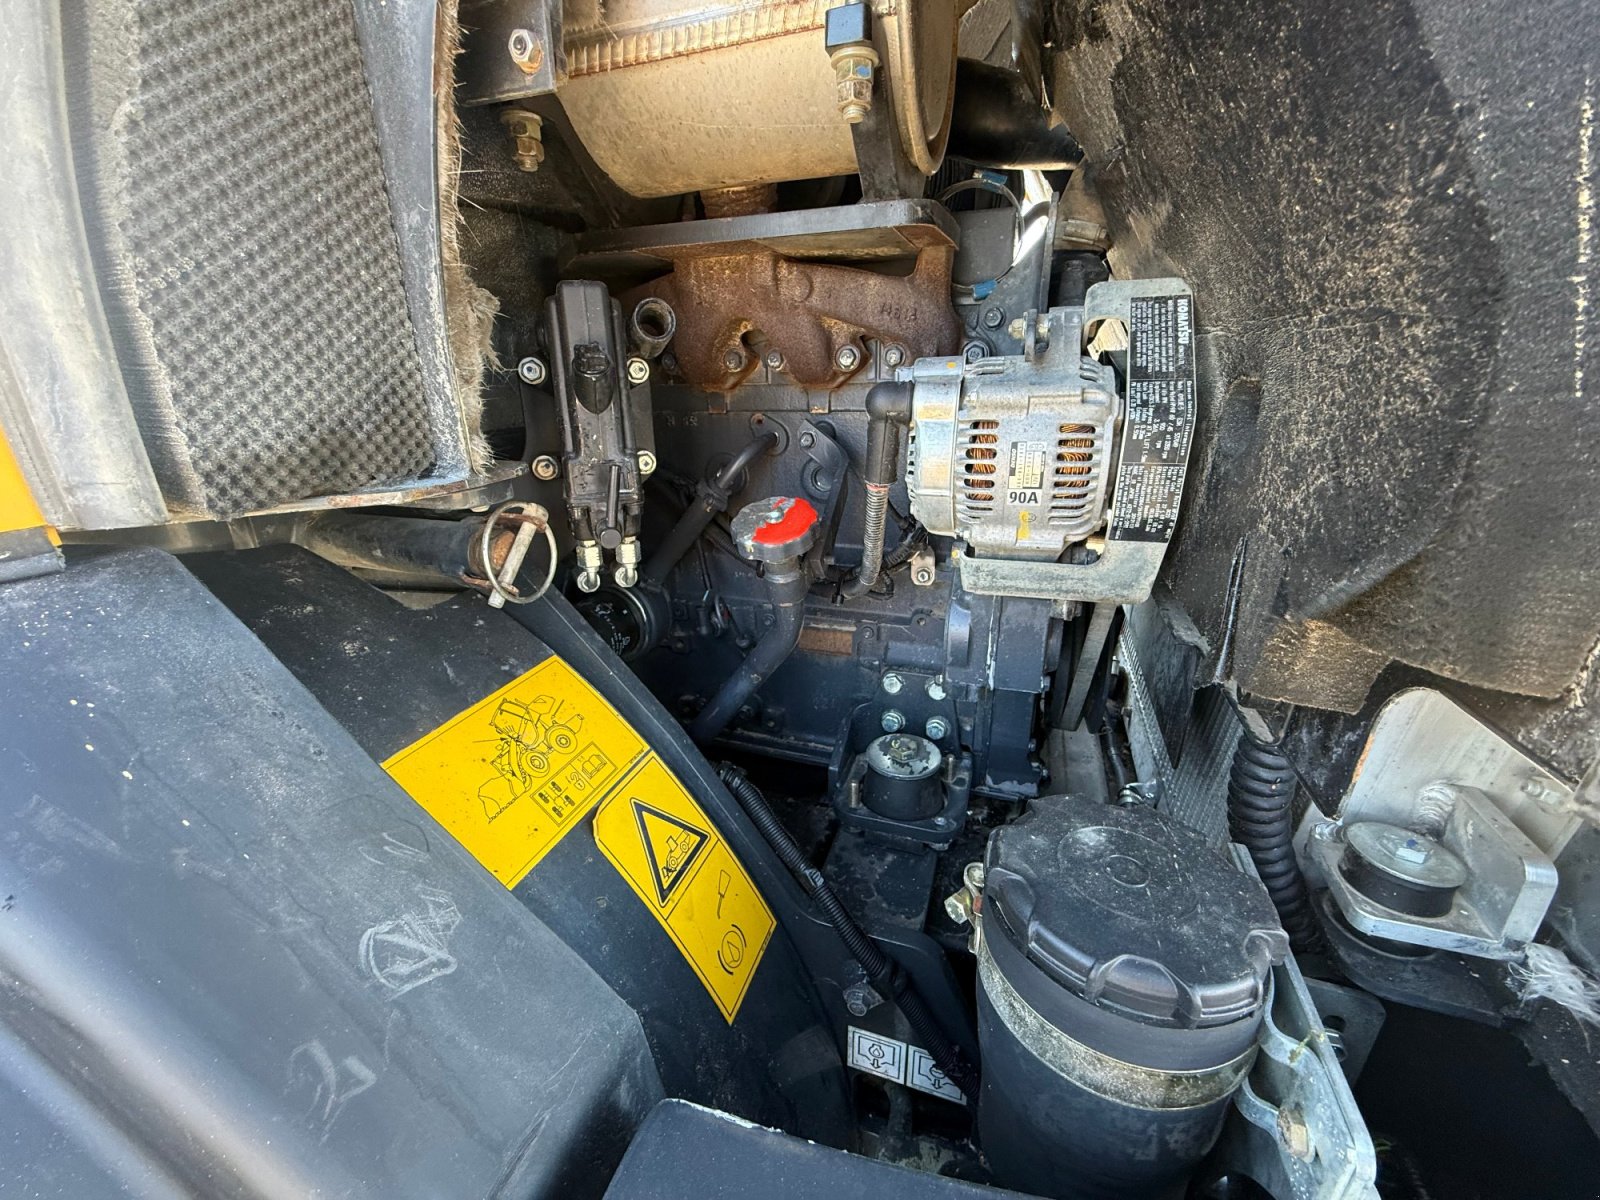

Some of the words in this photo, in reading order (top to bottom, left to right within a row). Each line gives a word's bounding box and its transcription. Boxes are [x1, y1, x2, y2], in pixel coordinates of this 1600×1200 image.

[1177, 299, 1191, 344] KOMATSU
[1142, 438, 1151, 450] LIFT
[1009, 491, 1039, 504] 90A
